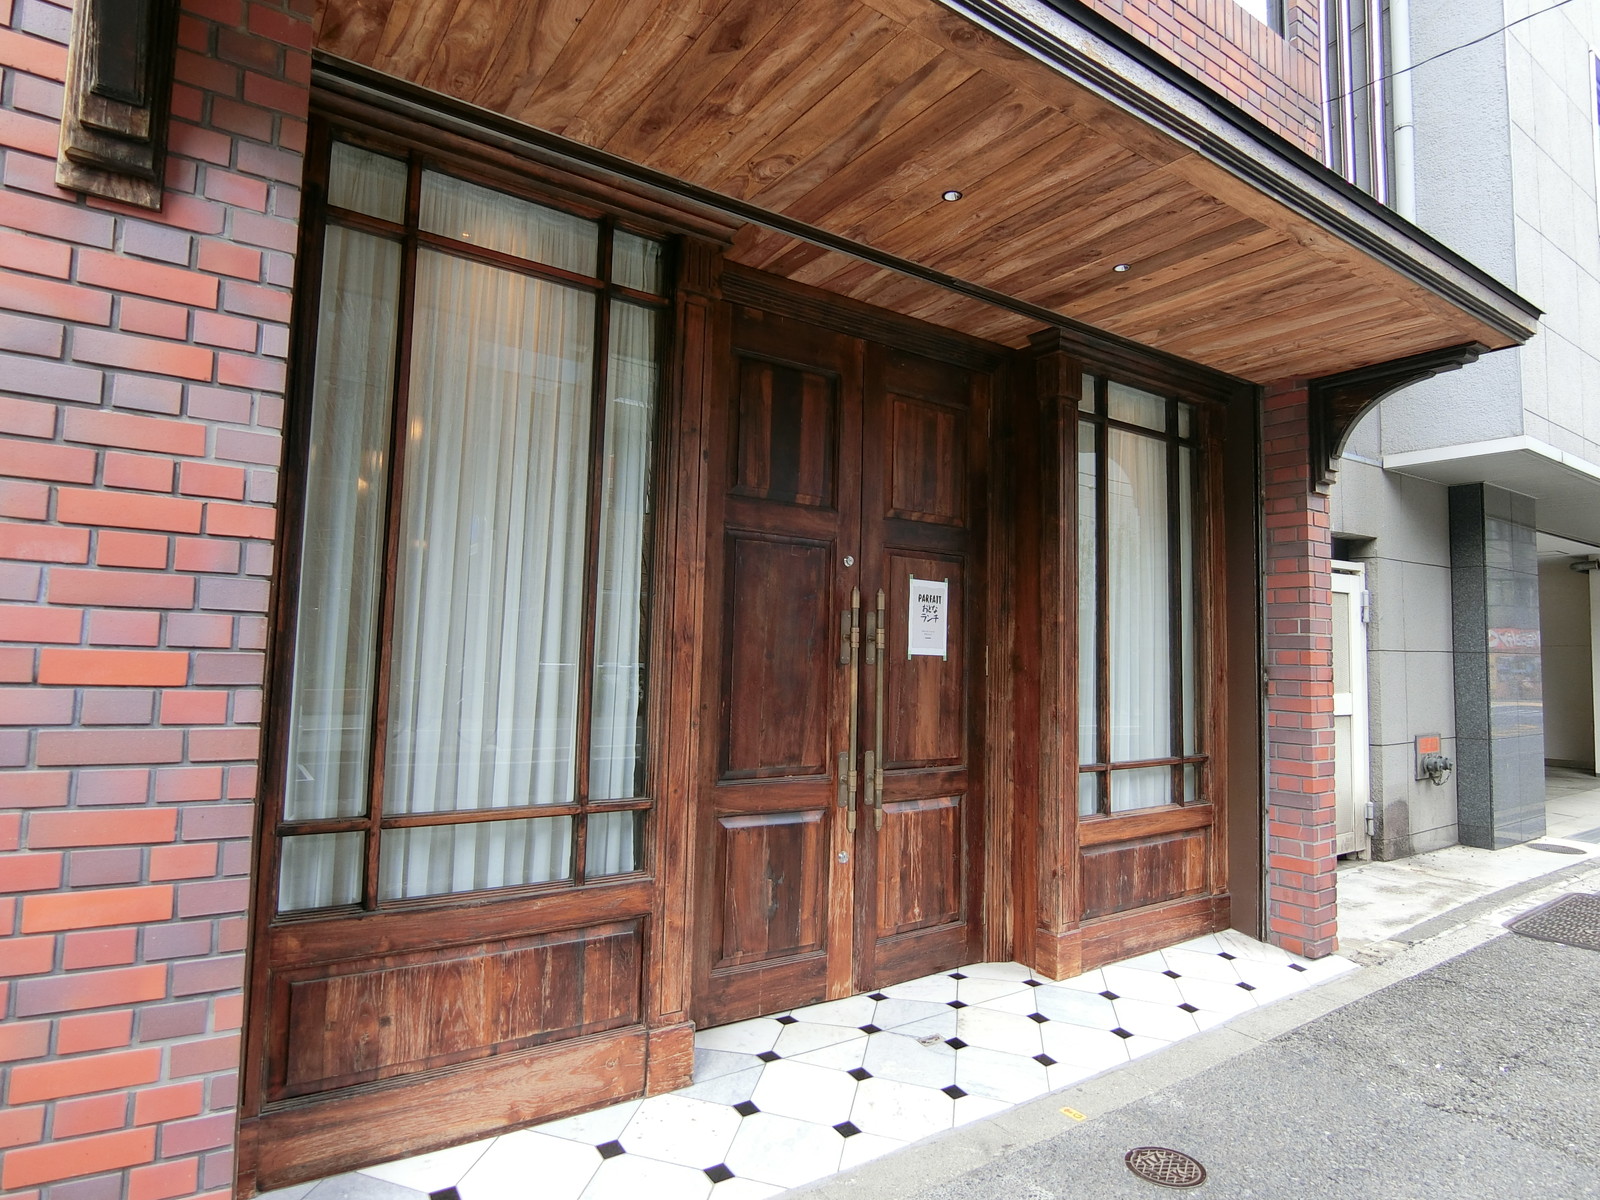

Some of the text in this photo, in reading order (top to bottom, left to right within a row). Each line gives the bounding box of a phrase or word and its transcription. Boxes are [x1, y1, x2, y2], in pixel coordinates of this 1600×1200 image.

[918, 593, 942, 604] PARFAIT
[920, 613, 939, 623] ランチ
